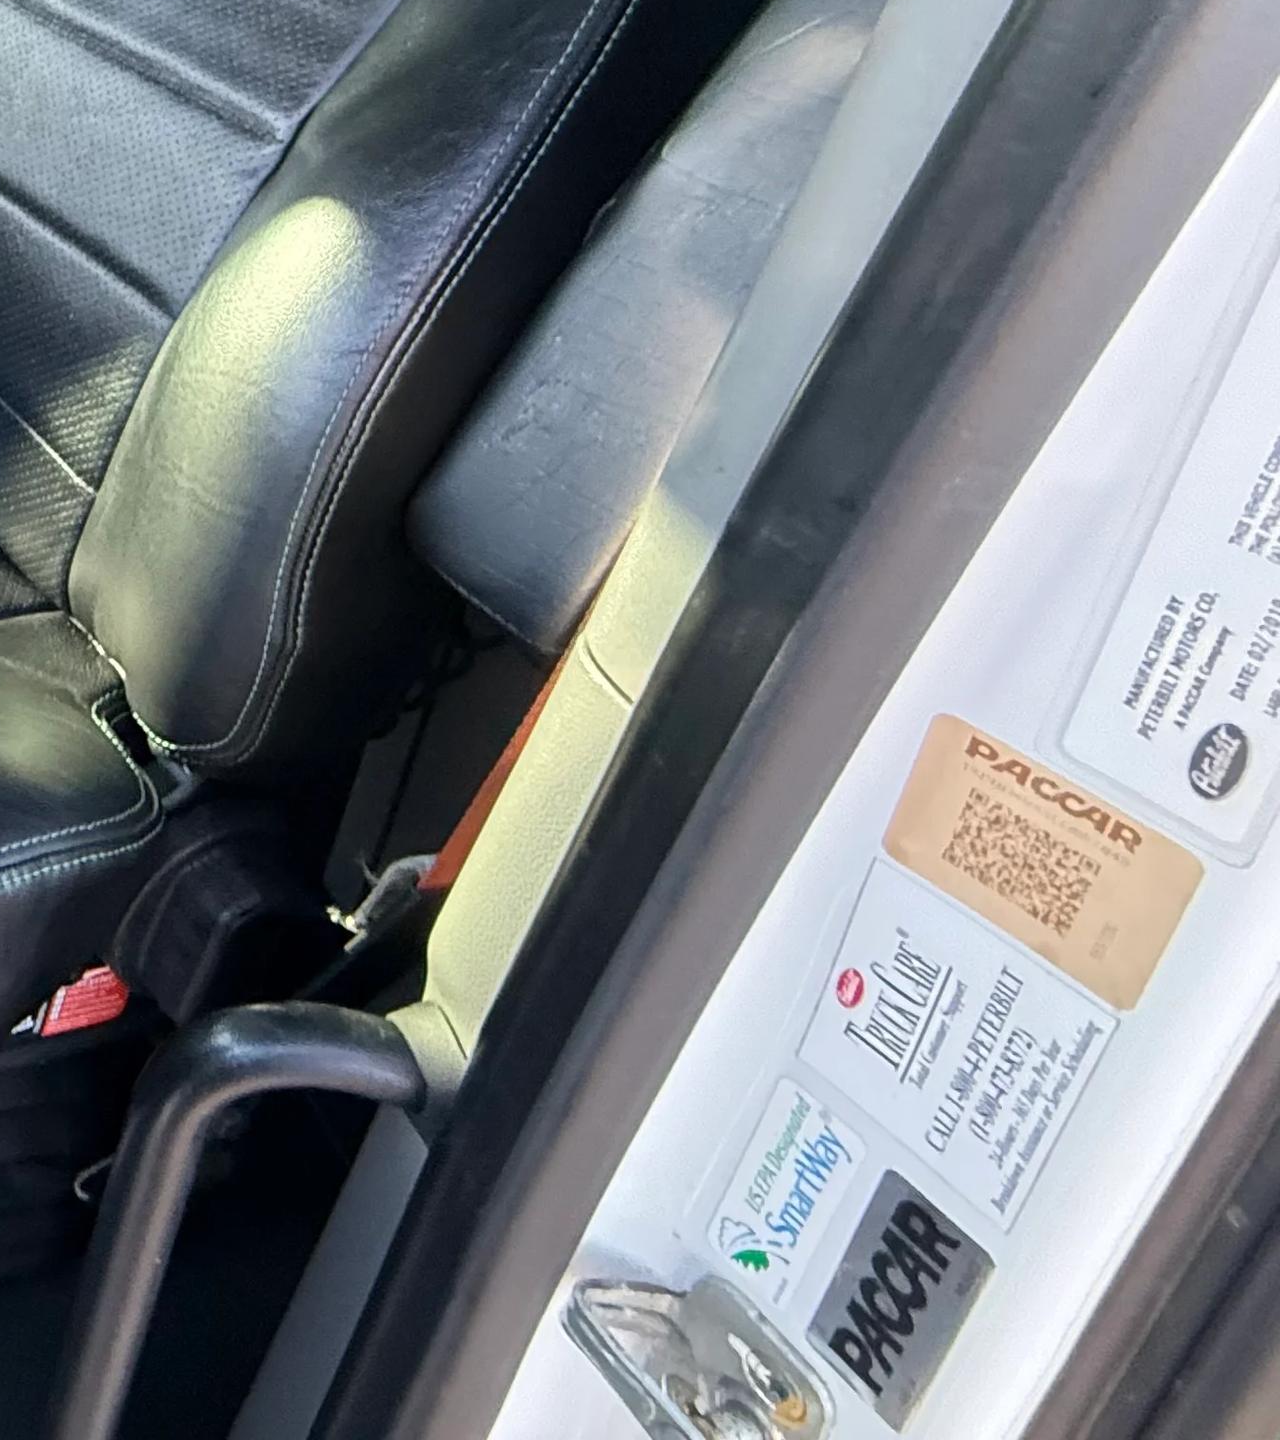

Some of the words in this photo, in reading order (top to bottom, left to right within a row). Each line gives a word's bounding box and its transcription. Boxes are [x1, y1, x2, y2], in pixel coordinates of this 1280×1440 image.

[1123, 613, 1178, 710] MANUFACTURED
[1165, 594, 1185, 615] BY
[1137, 665, 1181, 741] PETERBILT
[1169, 613, 1207, 672] MOTORS
[1178, 669, 1208, 722] PACCAR
[1198, 624, 1237, 677] Company
[964, 735, 1143, 856] PACCAR
[765, 1124, 853, 1249] SmartWay
[925, 1106, 957, 1153] CALL
[828, 1199, 962, 1397] PACCAR
